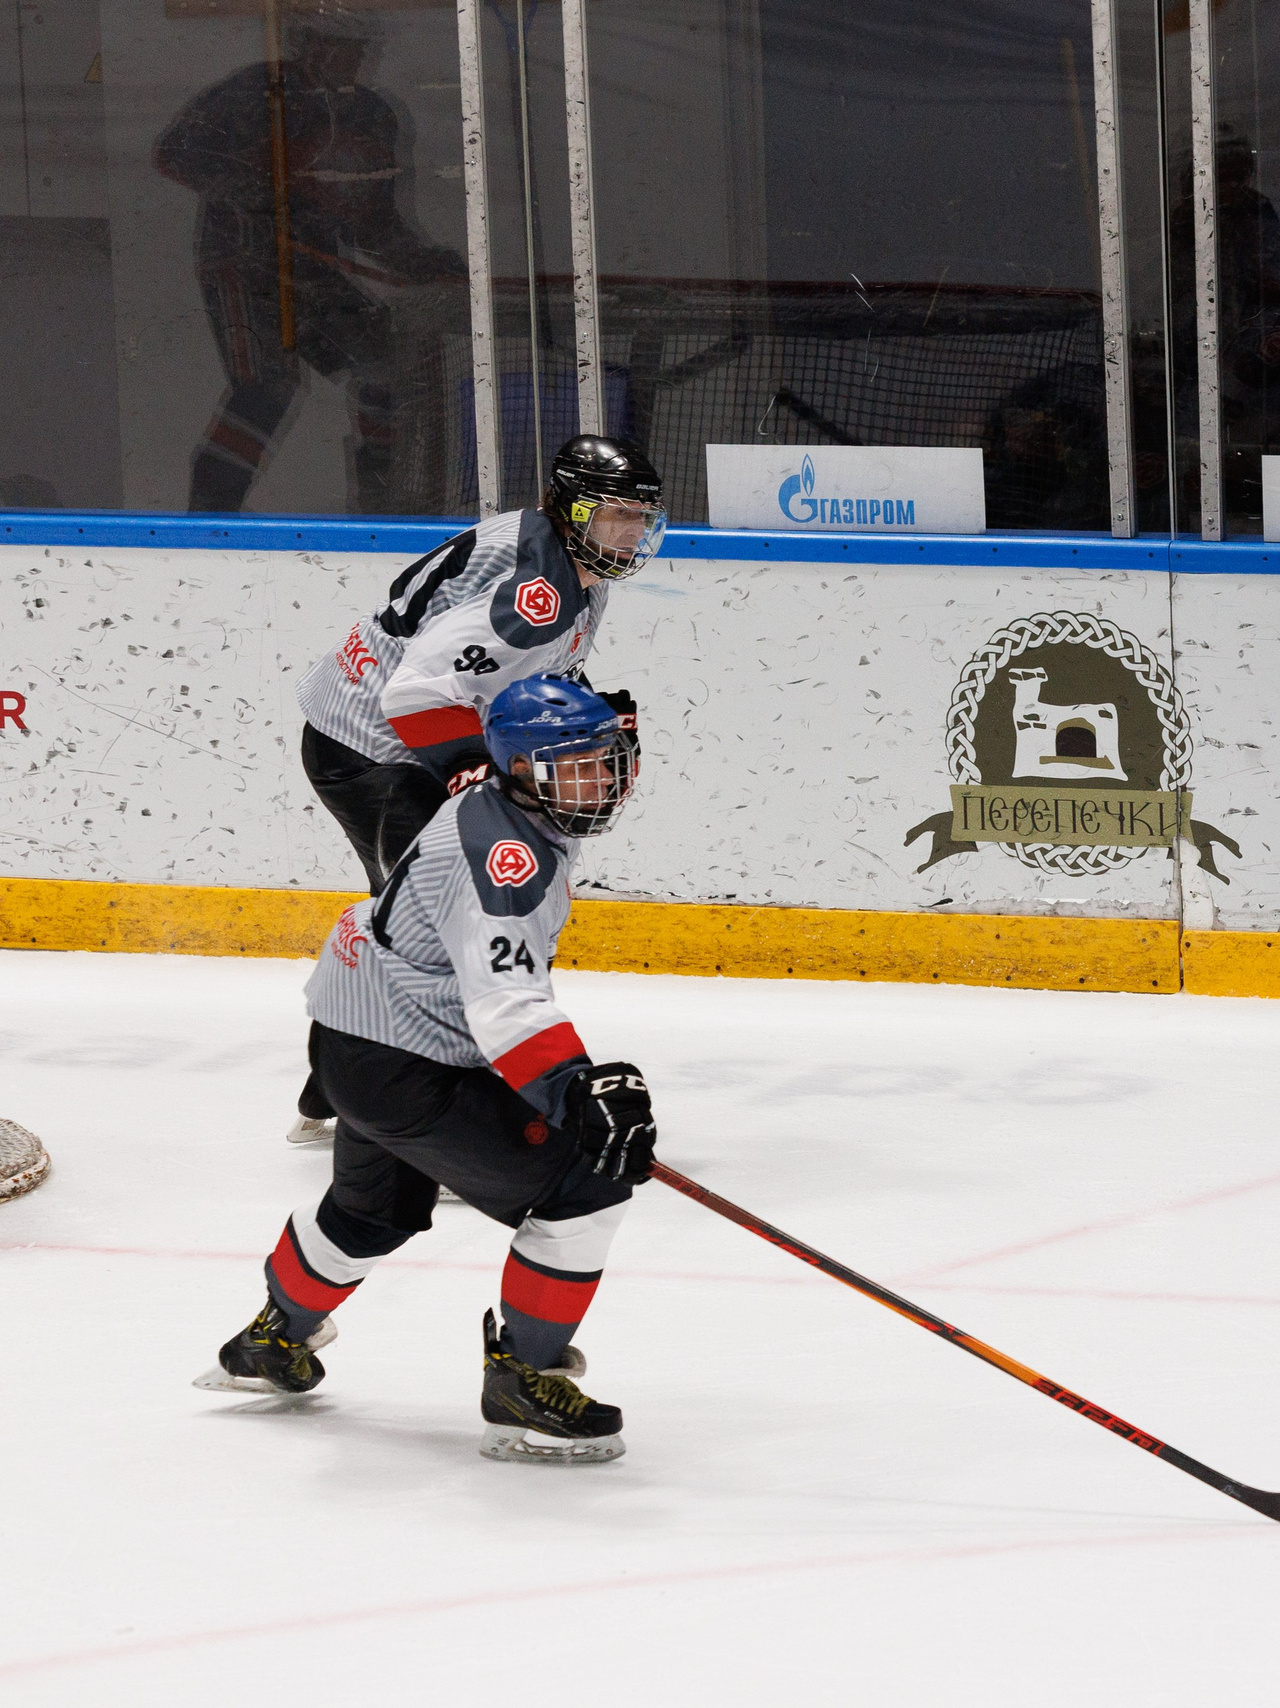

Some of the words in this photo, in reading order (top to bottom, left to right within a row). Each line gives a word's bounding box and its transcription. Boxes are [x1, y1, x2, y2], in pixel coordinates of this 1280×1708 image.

[635, 483, 660, 492] BAUER
[820, 498, 916, 526] ГАЗПРОМ
[527, 715, 562, 725] JOFA
[490, 935, 536, 975] 24
[590, 1074, 647, 1096] CC
